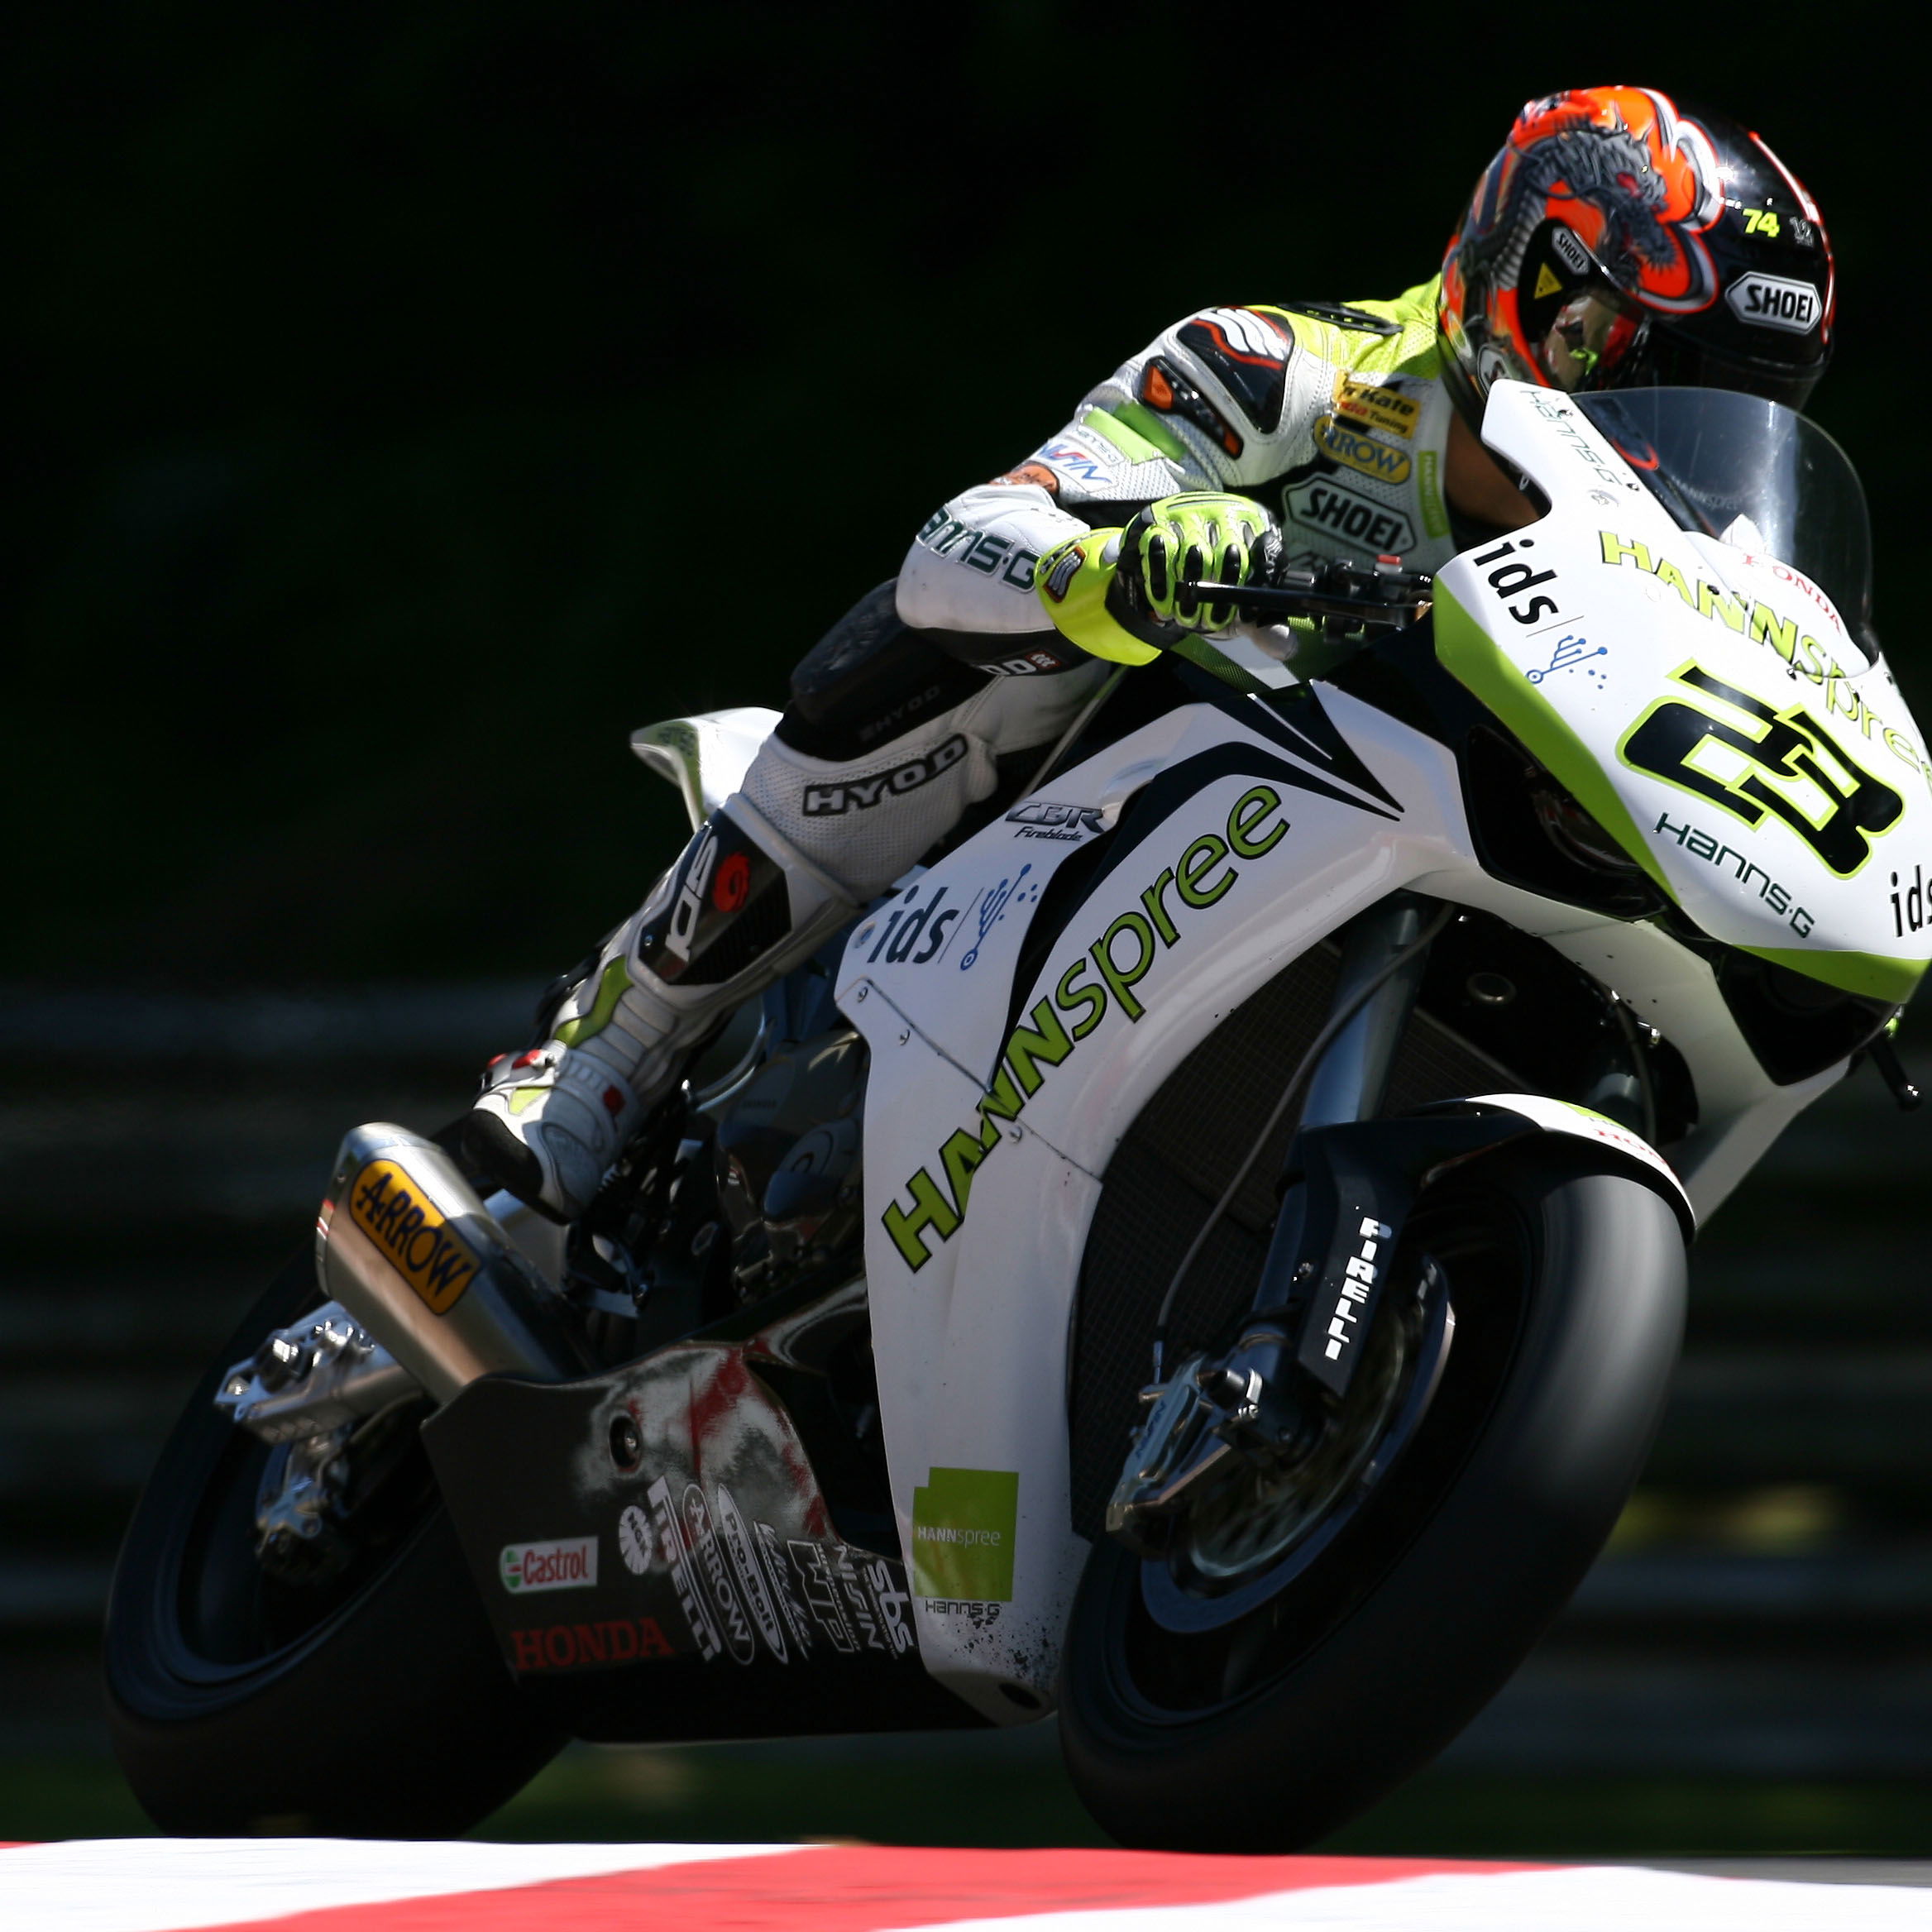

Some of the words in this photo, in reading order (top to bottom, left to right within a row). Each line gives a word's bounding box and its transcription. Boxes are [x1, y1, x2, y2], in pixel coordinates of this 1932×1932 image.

[1558, 232, 1585, 269] SHOEI
[1743, 208, 1780, 238] 74
[1744, 285, 1814, 323] SHOEI
[1300, 487, 1404, 552] SHOEI
[1473, 538, 1560, 625] ids
[803, 734, 968, 816] HYOD
[1614, 656, 1906, 881] 23
[1005, 801, 1106, 834] CBR
[1014, 826, 1084, 842] Fireblade
[867, 886, 960, 964] ids
[356, 1172, 473, 1298] ARROW
[1324, 1216, 1393, 1361] PIRELLI
[523, 1544, 588, 1585] Castrol
[647, 1475, 722, 1662] PIRELLI
[690, 1498, 751, 1641] ARROW
[724, 1512, 775, 1634] Pro-Bolt
[917, 1525, 1002, 1549] HANNspree
[787, 1540, 856, 1653] WP
[833, 1544, 886, 1649] NISIN
[871, 1559, 915, 1654] sbs
[510, 1616, 677, 1671] HONDA
